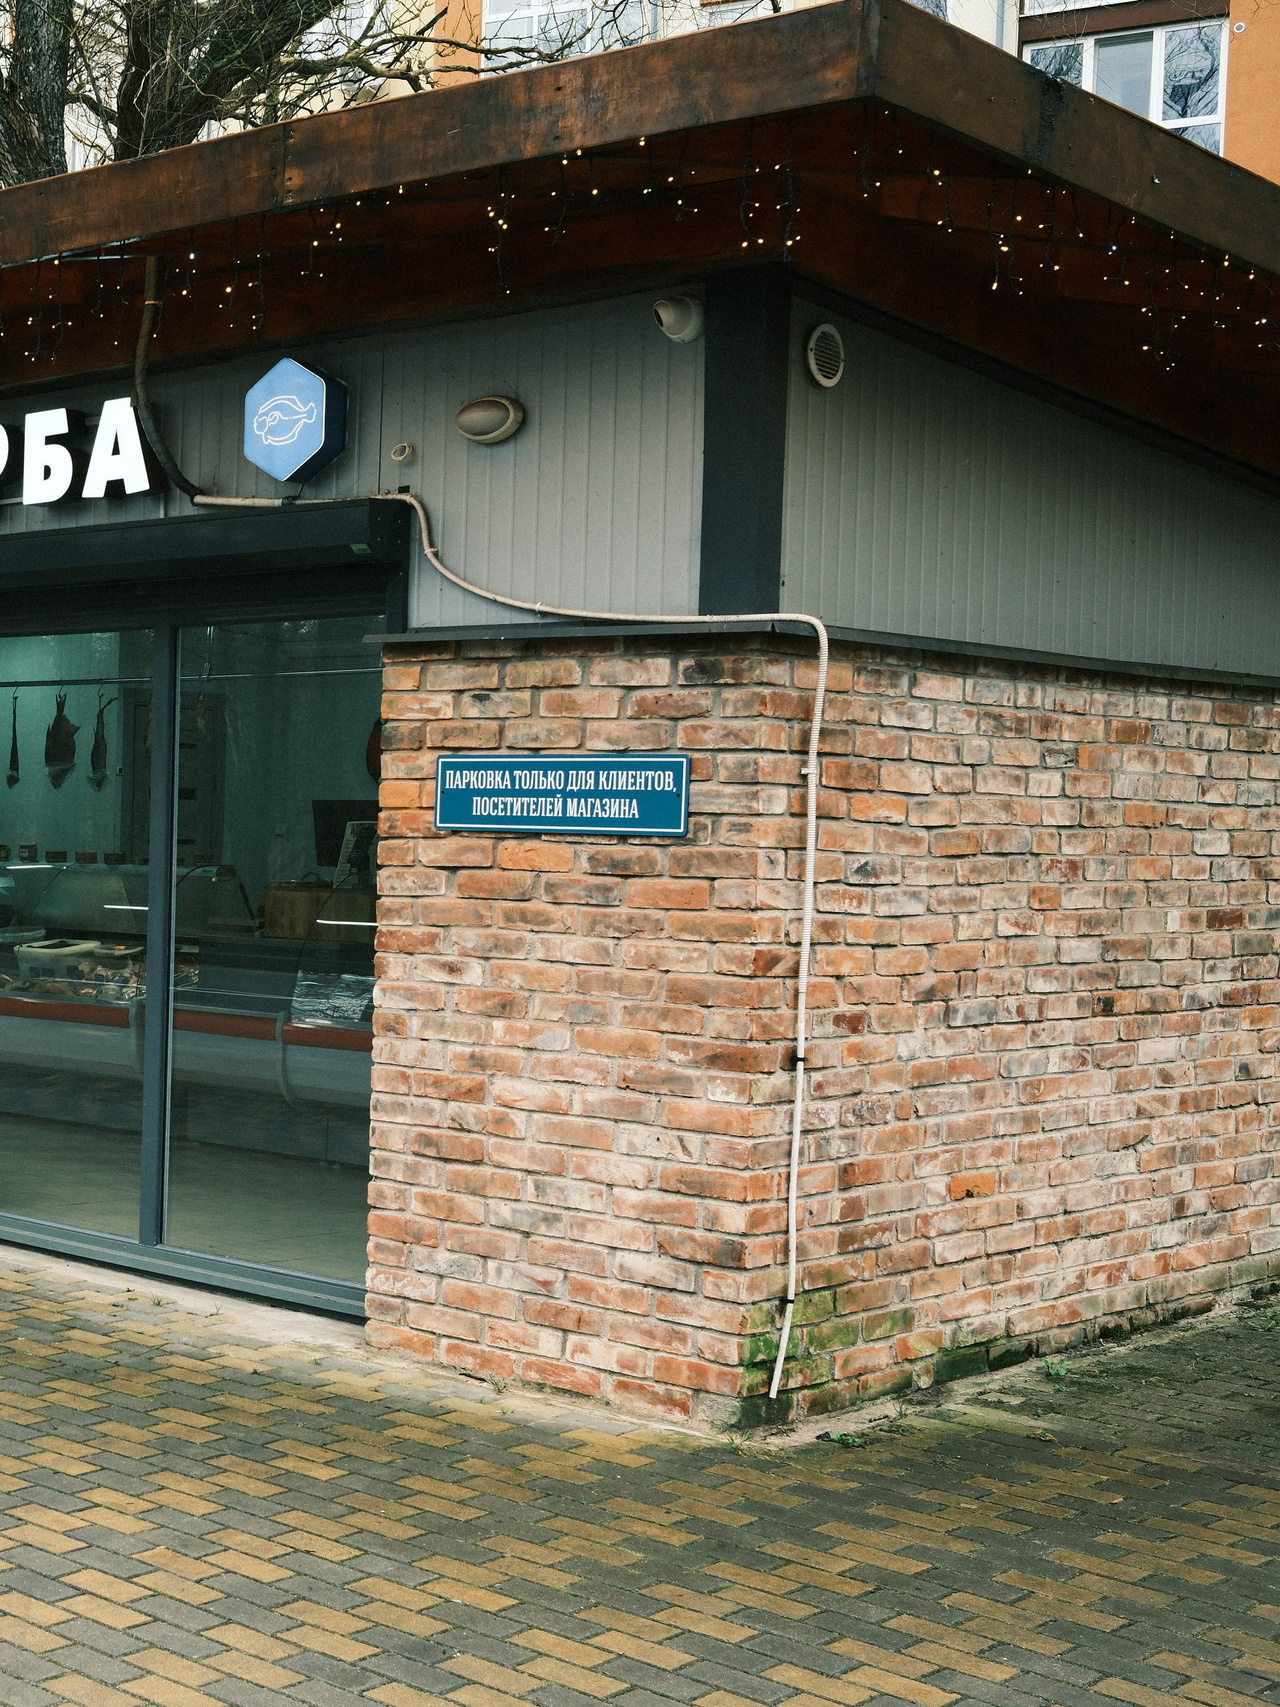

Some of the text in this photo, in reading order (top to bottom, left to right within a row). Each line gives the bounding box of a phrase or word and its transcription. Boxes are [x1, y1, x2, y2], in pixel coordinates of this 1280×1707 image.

[445, 770, 677, 793] ПАРКОВКА ТОЛЬКО ДЛЯ КЛИЕНТОВ,
[472, 794, 639, 819] ПОСЕТИТЕЛЕЙ МАГАЗИНА
